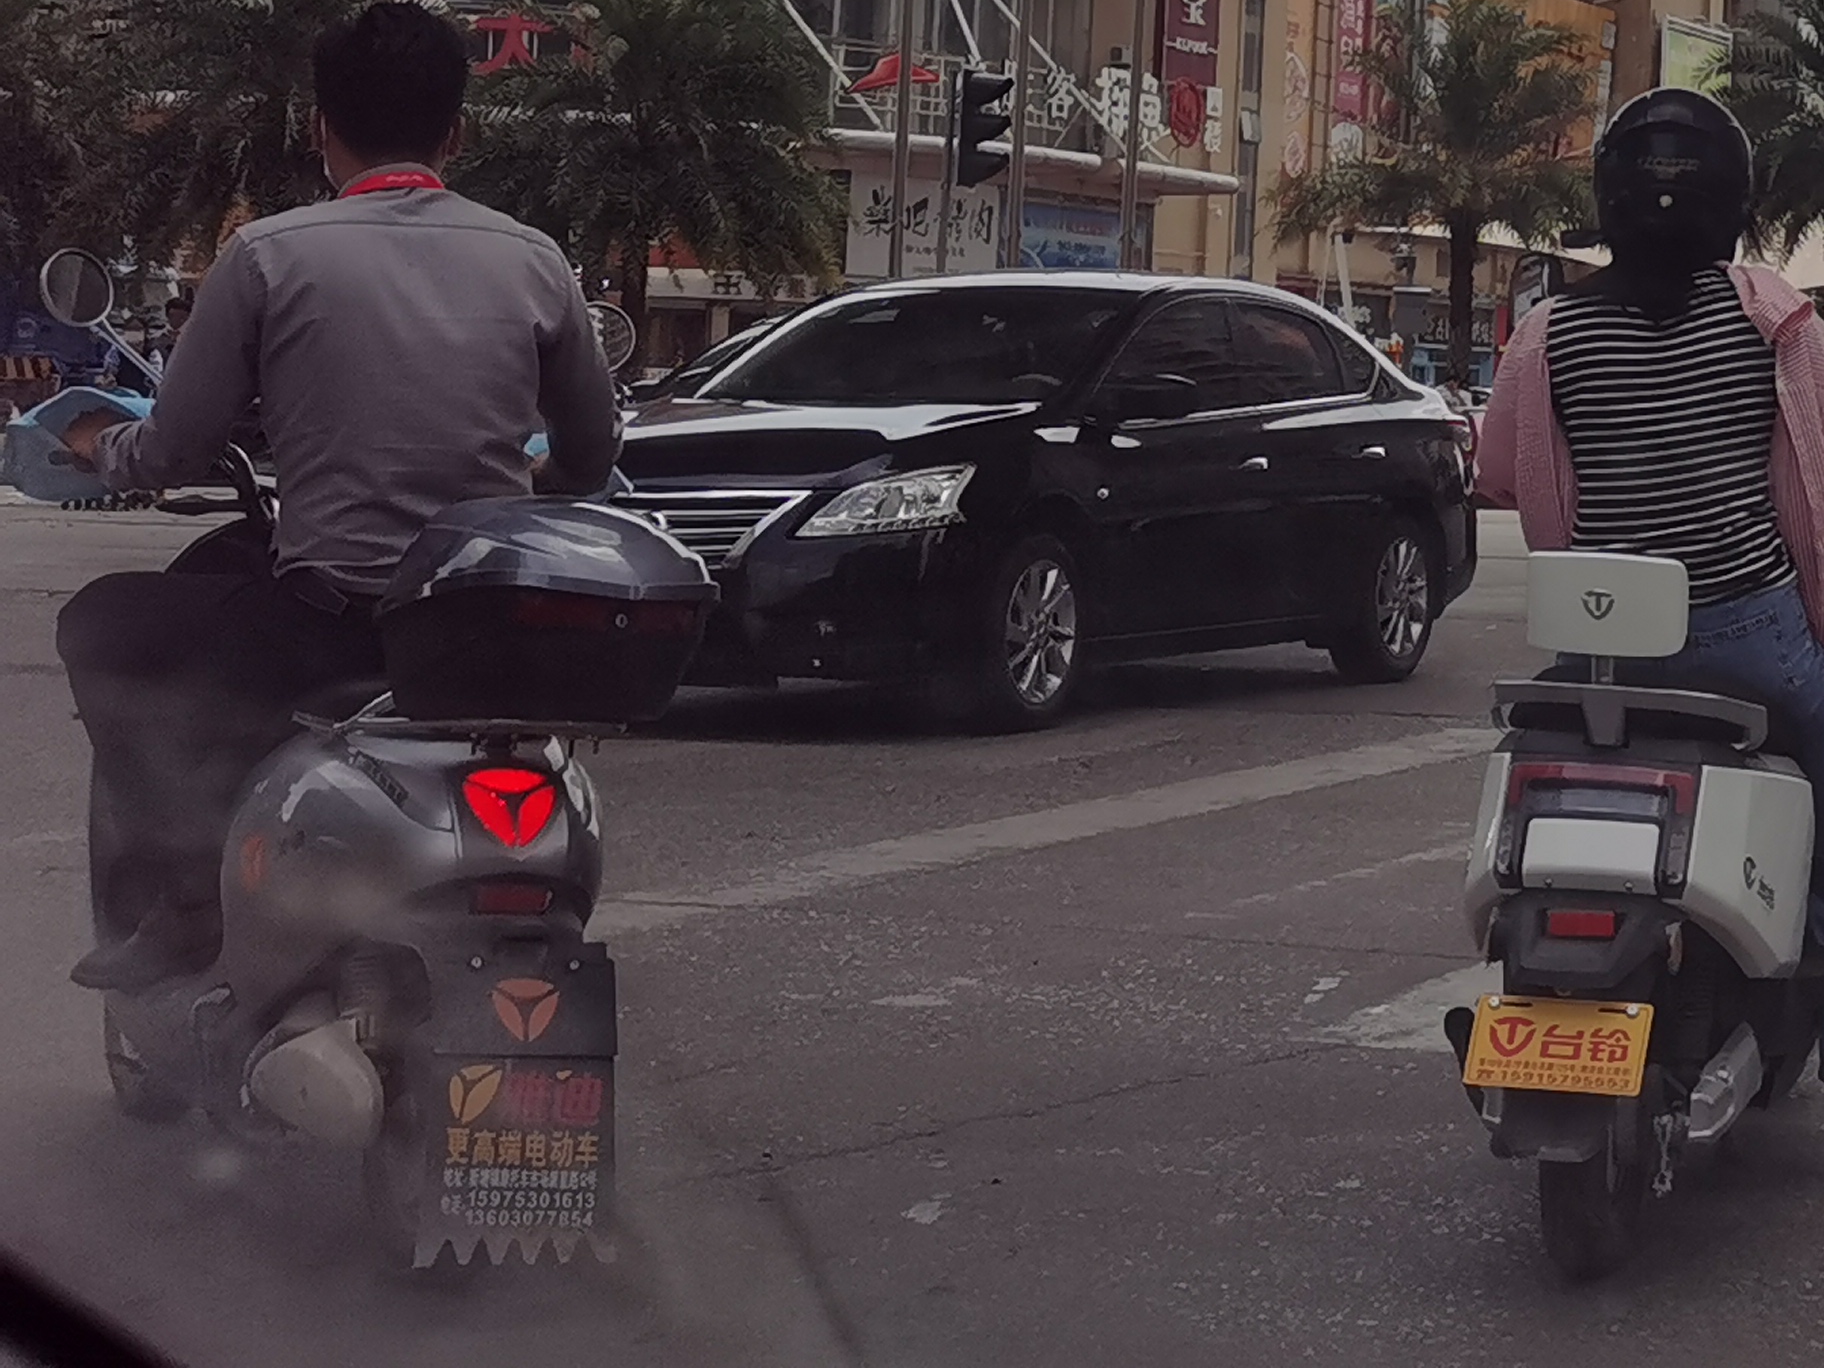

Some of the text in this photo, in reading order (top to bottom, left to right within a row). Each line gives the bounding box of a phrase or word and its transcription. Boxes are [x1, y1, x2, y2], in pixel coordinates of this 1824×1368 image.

[446, 1128, 599, 1168] 更高端电动车
[467, 1189, 597, 1211] 15975301613
